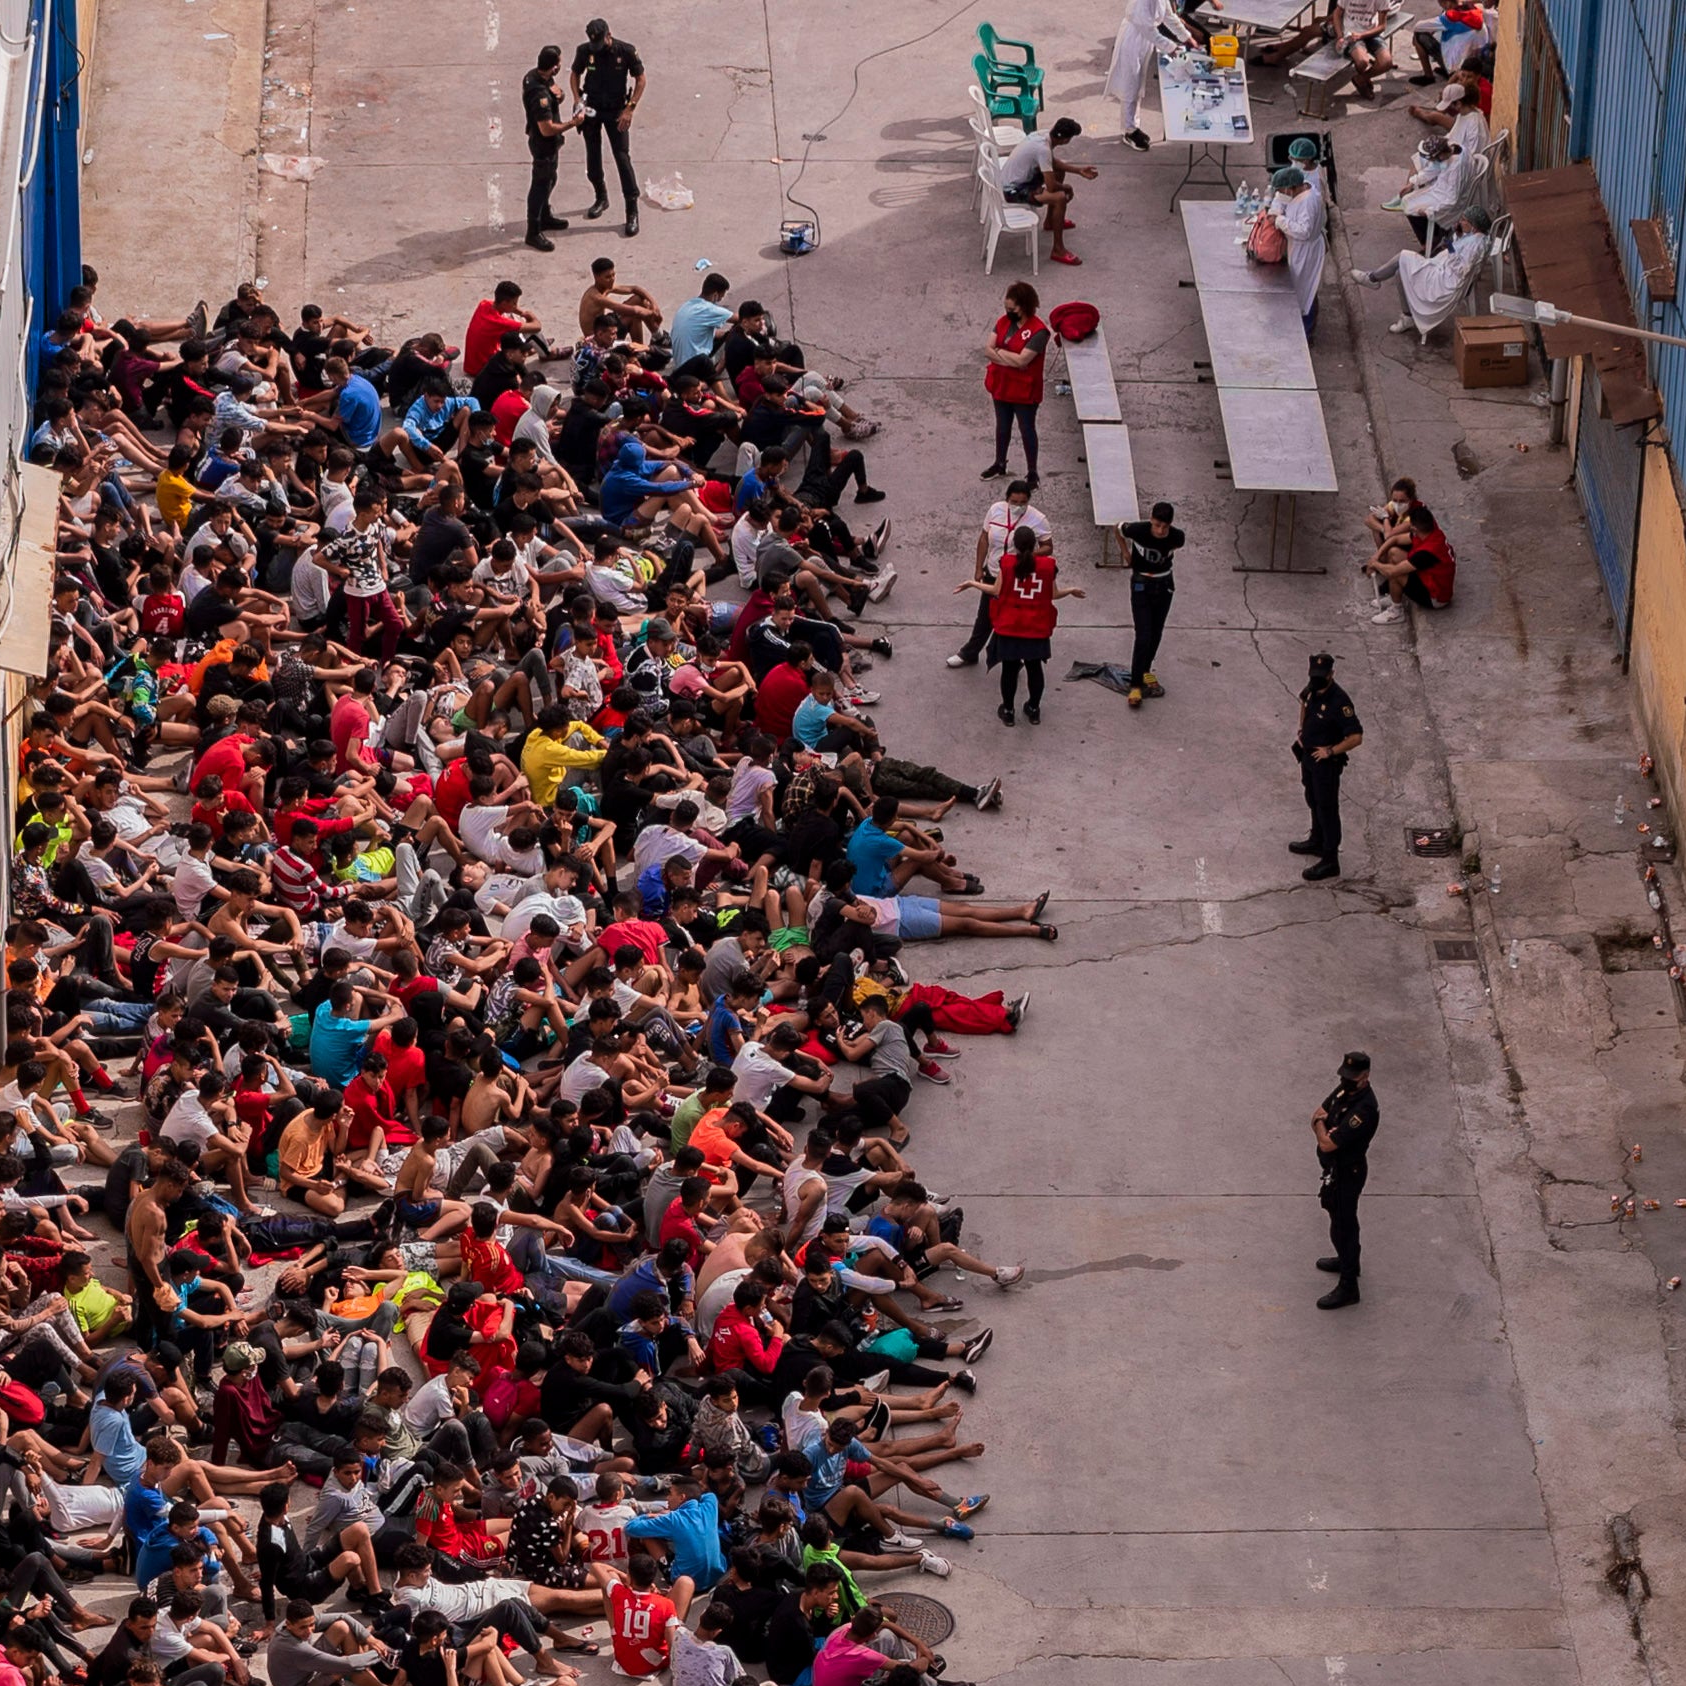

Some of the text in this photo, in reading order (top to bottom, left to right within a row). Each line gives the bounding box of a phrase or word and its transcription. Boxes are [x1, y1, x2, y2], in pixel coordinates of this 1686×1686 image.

[155, 616, 170, 635] 4
[588, 1528, 627, 1561] 21
[622, 1608, 651, 1639] 19
